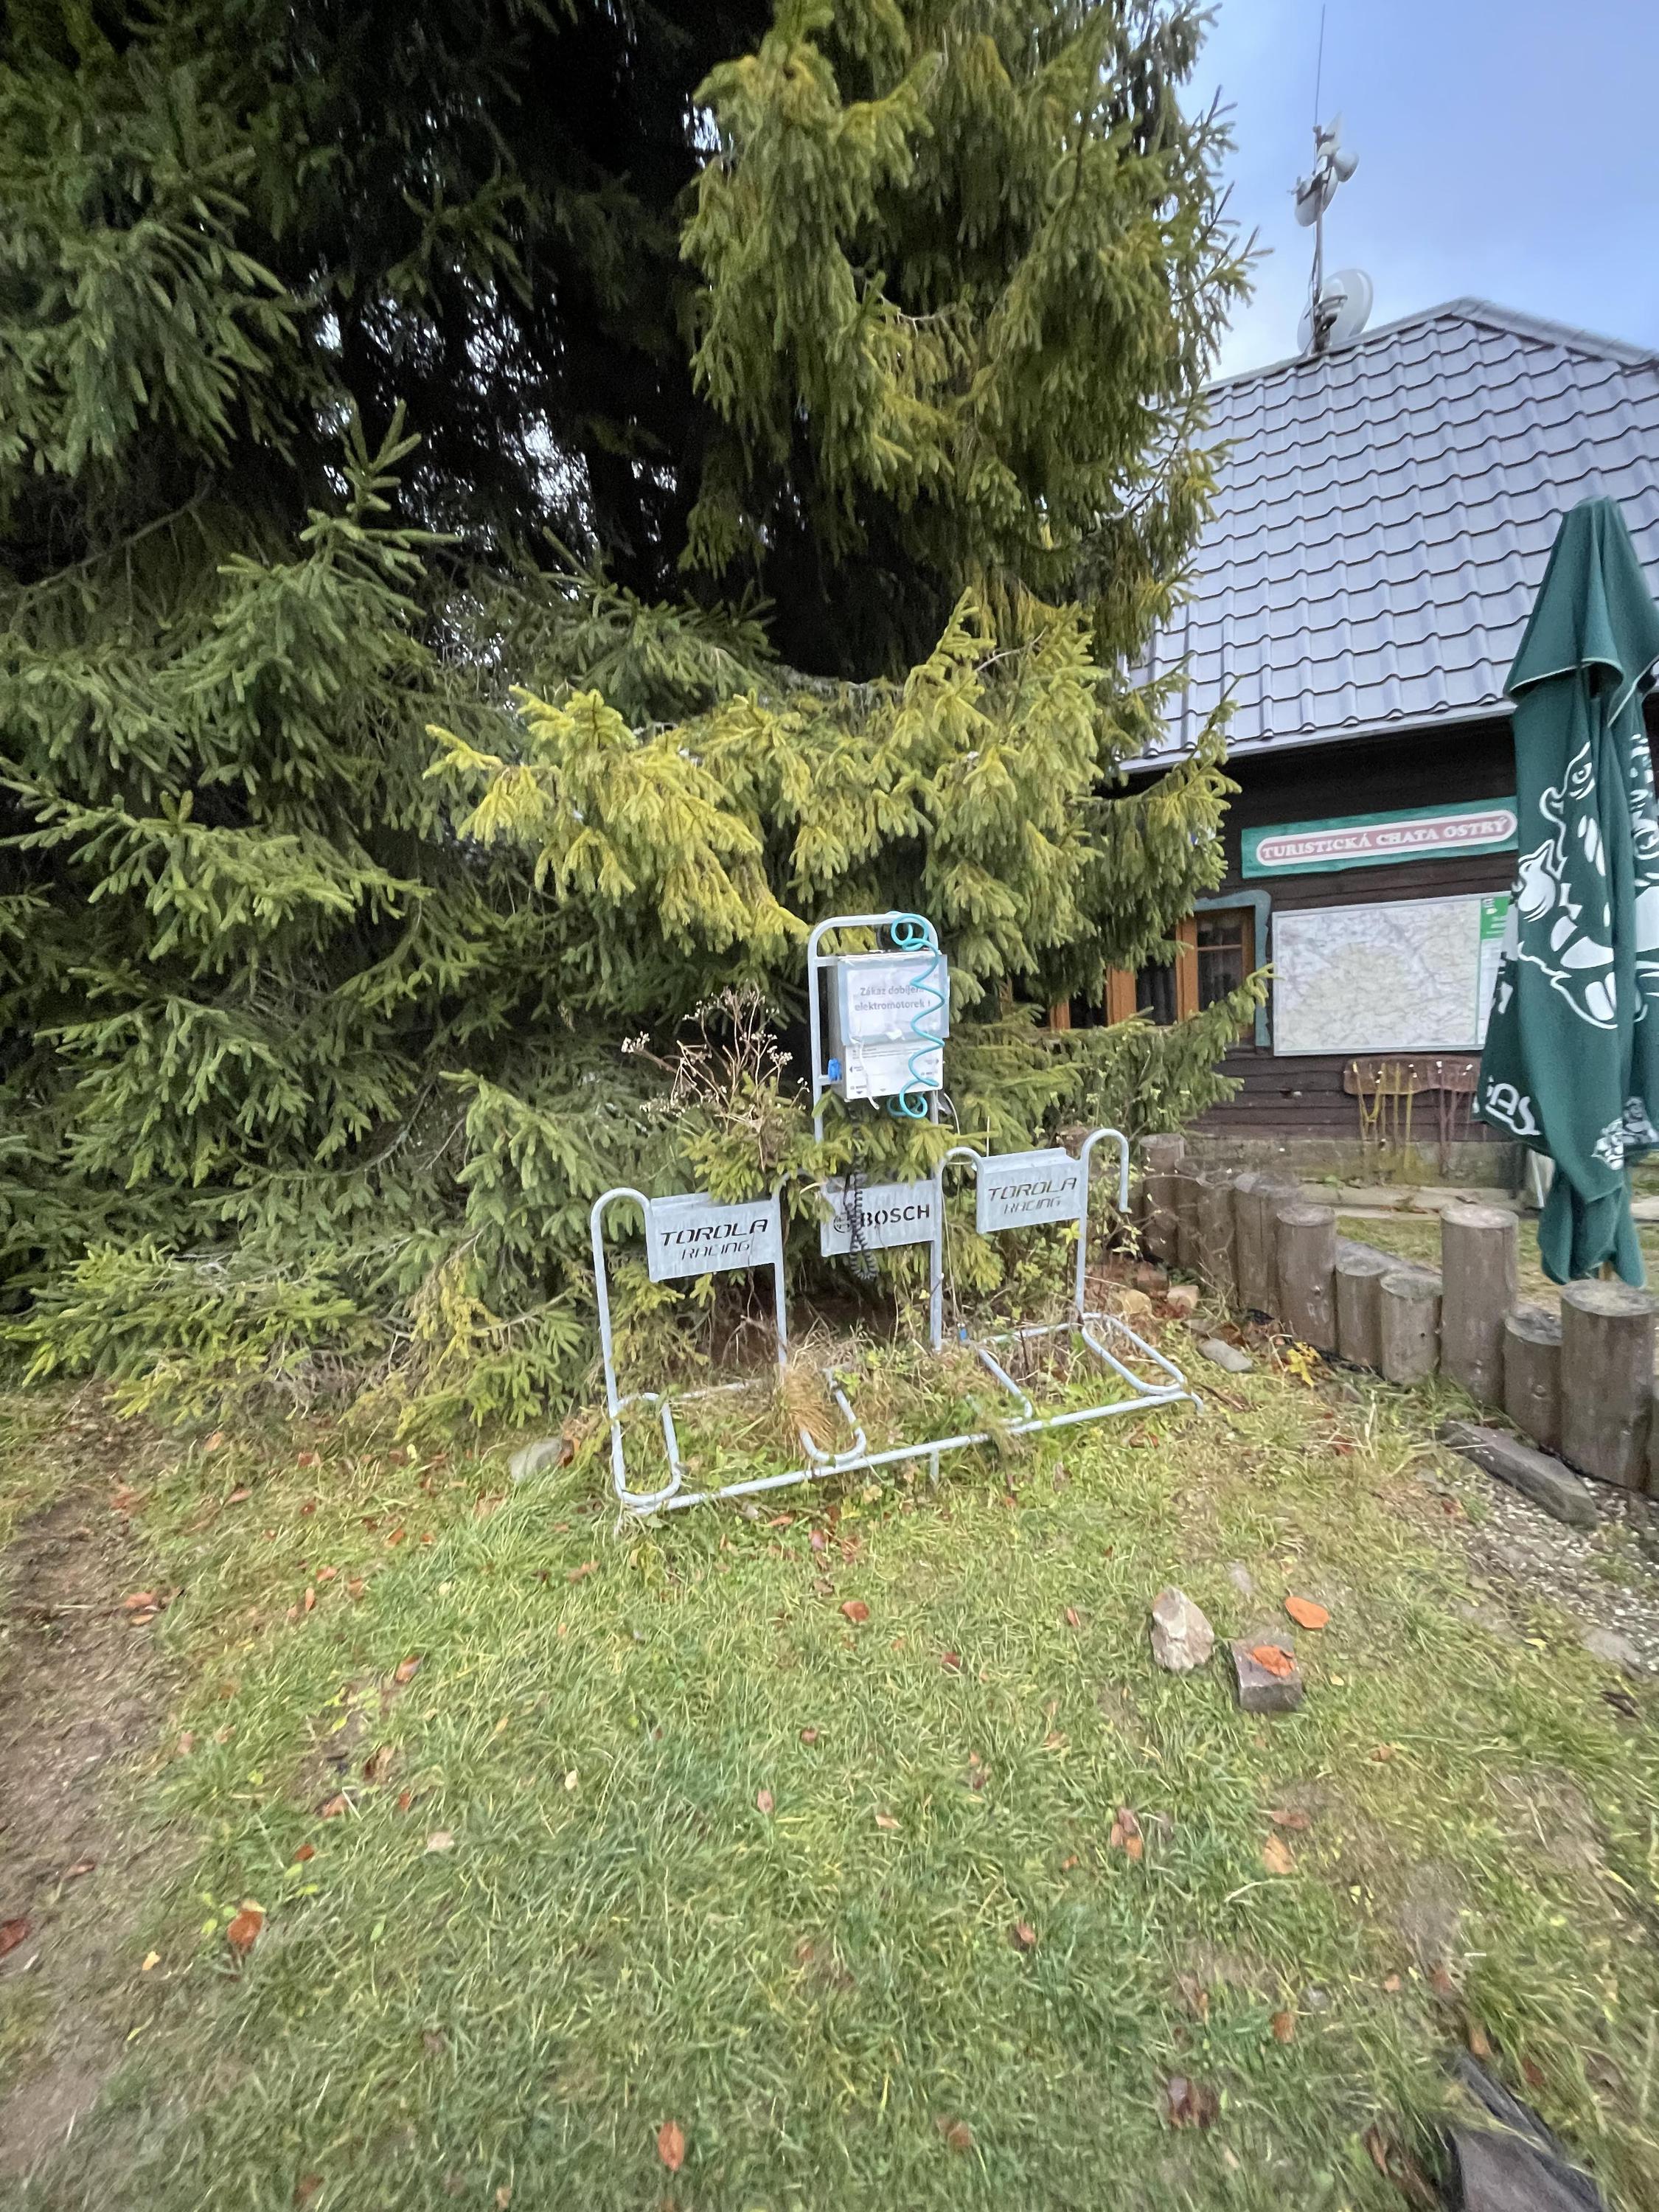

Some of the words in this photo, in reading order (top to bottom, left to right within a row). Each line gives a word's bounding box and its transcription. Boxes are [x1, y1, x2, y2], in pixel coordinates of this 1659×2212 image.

[1262, 833, 1372, 859] TURISTICKÁ
[1375, 827, 1439, 846] CHATA
[1444, 816, 1509, 838] OSTRÝ
[860, 987, 886, 996] Zákaz
[888, 985, 925, 995] dobíje
[855, 998, 925, 1011] elektromotorek
[988, 1177, 1077, 1202] TOROLA
[860, 1203, 931, 1228] BOSCH
[661, 1219, 768, 1246] TOROLA
